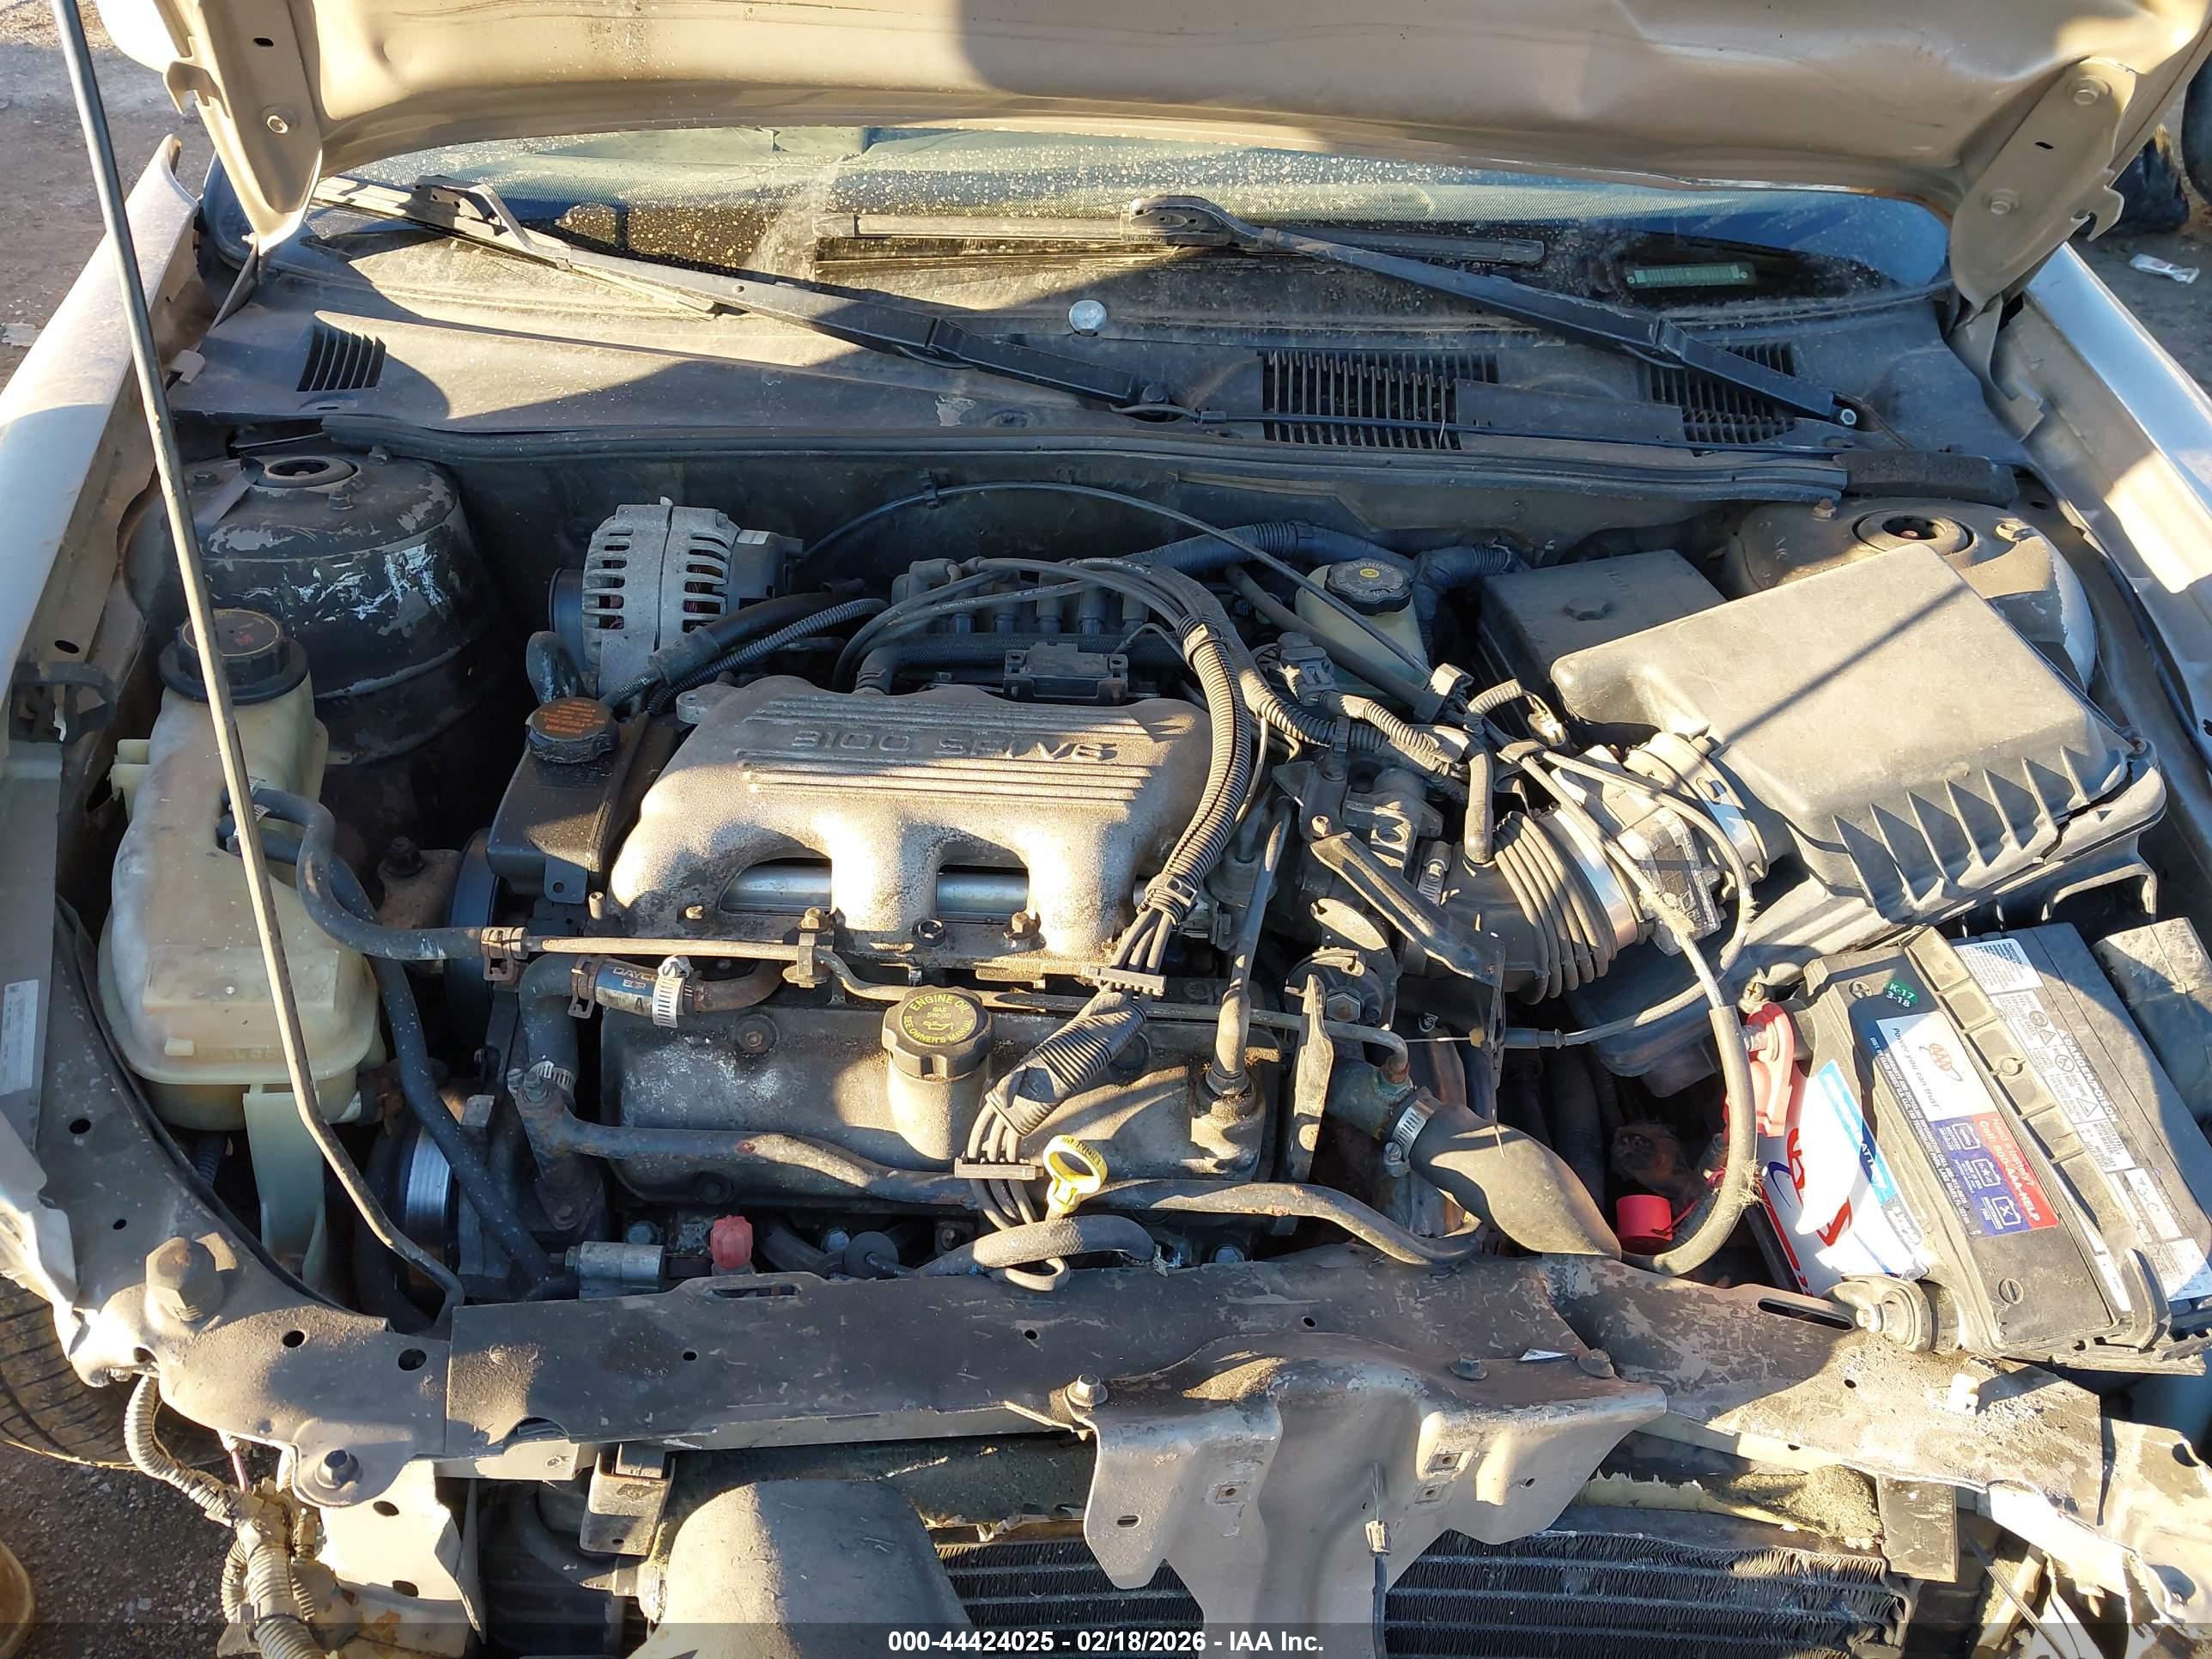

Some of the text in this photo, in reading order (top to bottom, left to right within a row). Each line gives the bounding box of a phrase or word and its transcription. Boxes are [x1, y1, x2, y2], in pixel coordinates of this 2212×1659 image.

[790, 730, 911, 752] 3100
[909, 994, 971, 1014] ENGINE OIL
[1886, 990, 1911, 1007] 3-18
[1889, 982, 1915, 1000] K-17
[903, 1015, 975, 1043] SEE OWNER'S MANUAL
[1890, 1027, 1911, 1053] Power
[1904, 1054, 1918, 1070] you
[1914, 1071, 1928, 1085] can
[2063, 1037, 2119, 1121] DANGER/POISON
[1879, 1056, 1891, 1070] CLUB
[1885, 1069, 1900, 1088] ASSIST
[1911, 1119, 1936, 1152] TECHNOLOGY
[1937, 1168, 1950, 1182] LAKE
[1882, 1052, 1903, 1079] WARRANTY
[1898, 1080, 1909, 1091] AND
[1904, 1091, 1923, 1118] RECYCLING
[1918, 1119, 1942, 1153] INFORMATION
[1936, 1153, 1949, 1167] CALL
[1978, 1120, 2041, 1222] Call: 800-AAA-HELP
[1990, 1118, 2010, 1140] Need
[2007, 1149, 2035, 1186] battery?
[1981, 1196, 2004, 1230] MAINTENANCE
